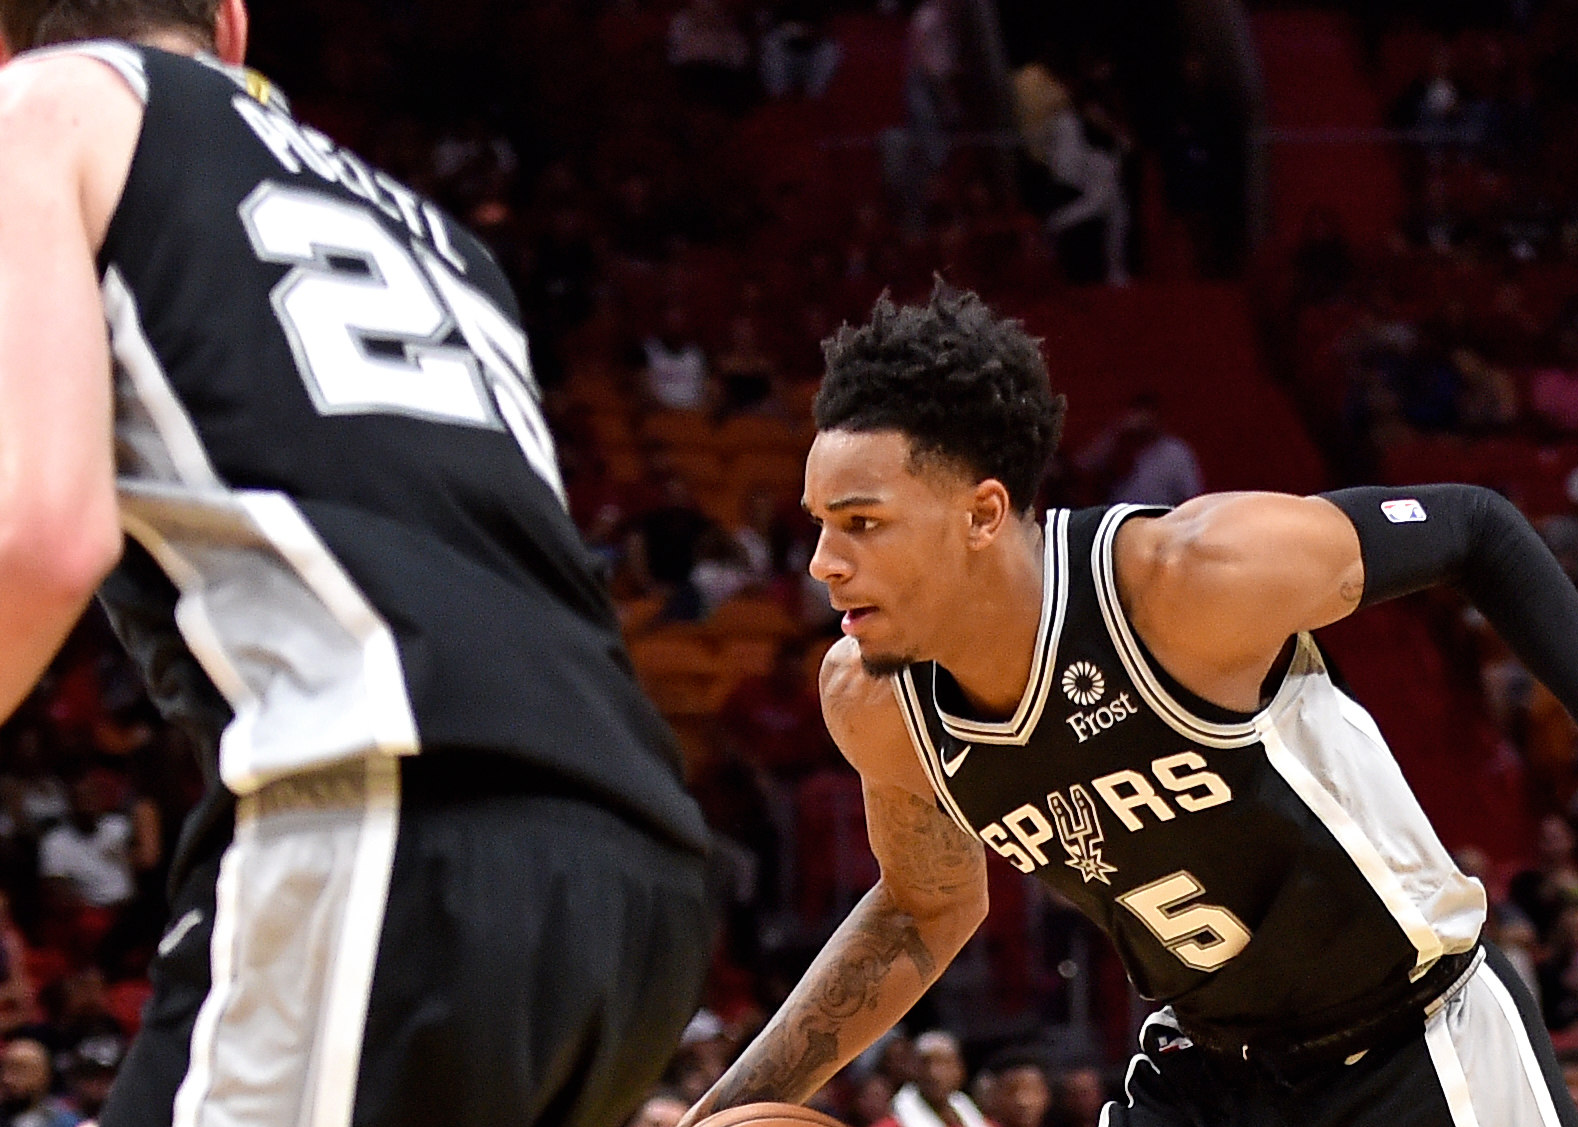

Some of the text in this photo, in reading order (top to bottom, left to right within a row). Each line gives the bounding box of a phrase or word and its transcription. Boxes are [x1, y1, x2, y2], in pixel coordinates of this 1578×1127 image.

[1065, 691, 1138, 743] Frost
[979, 750, 1232, 886] SPURS
[1114, 869, 1252, 973] 5
